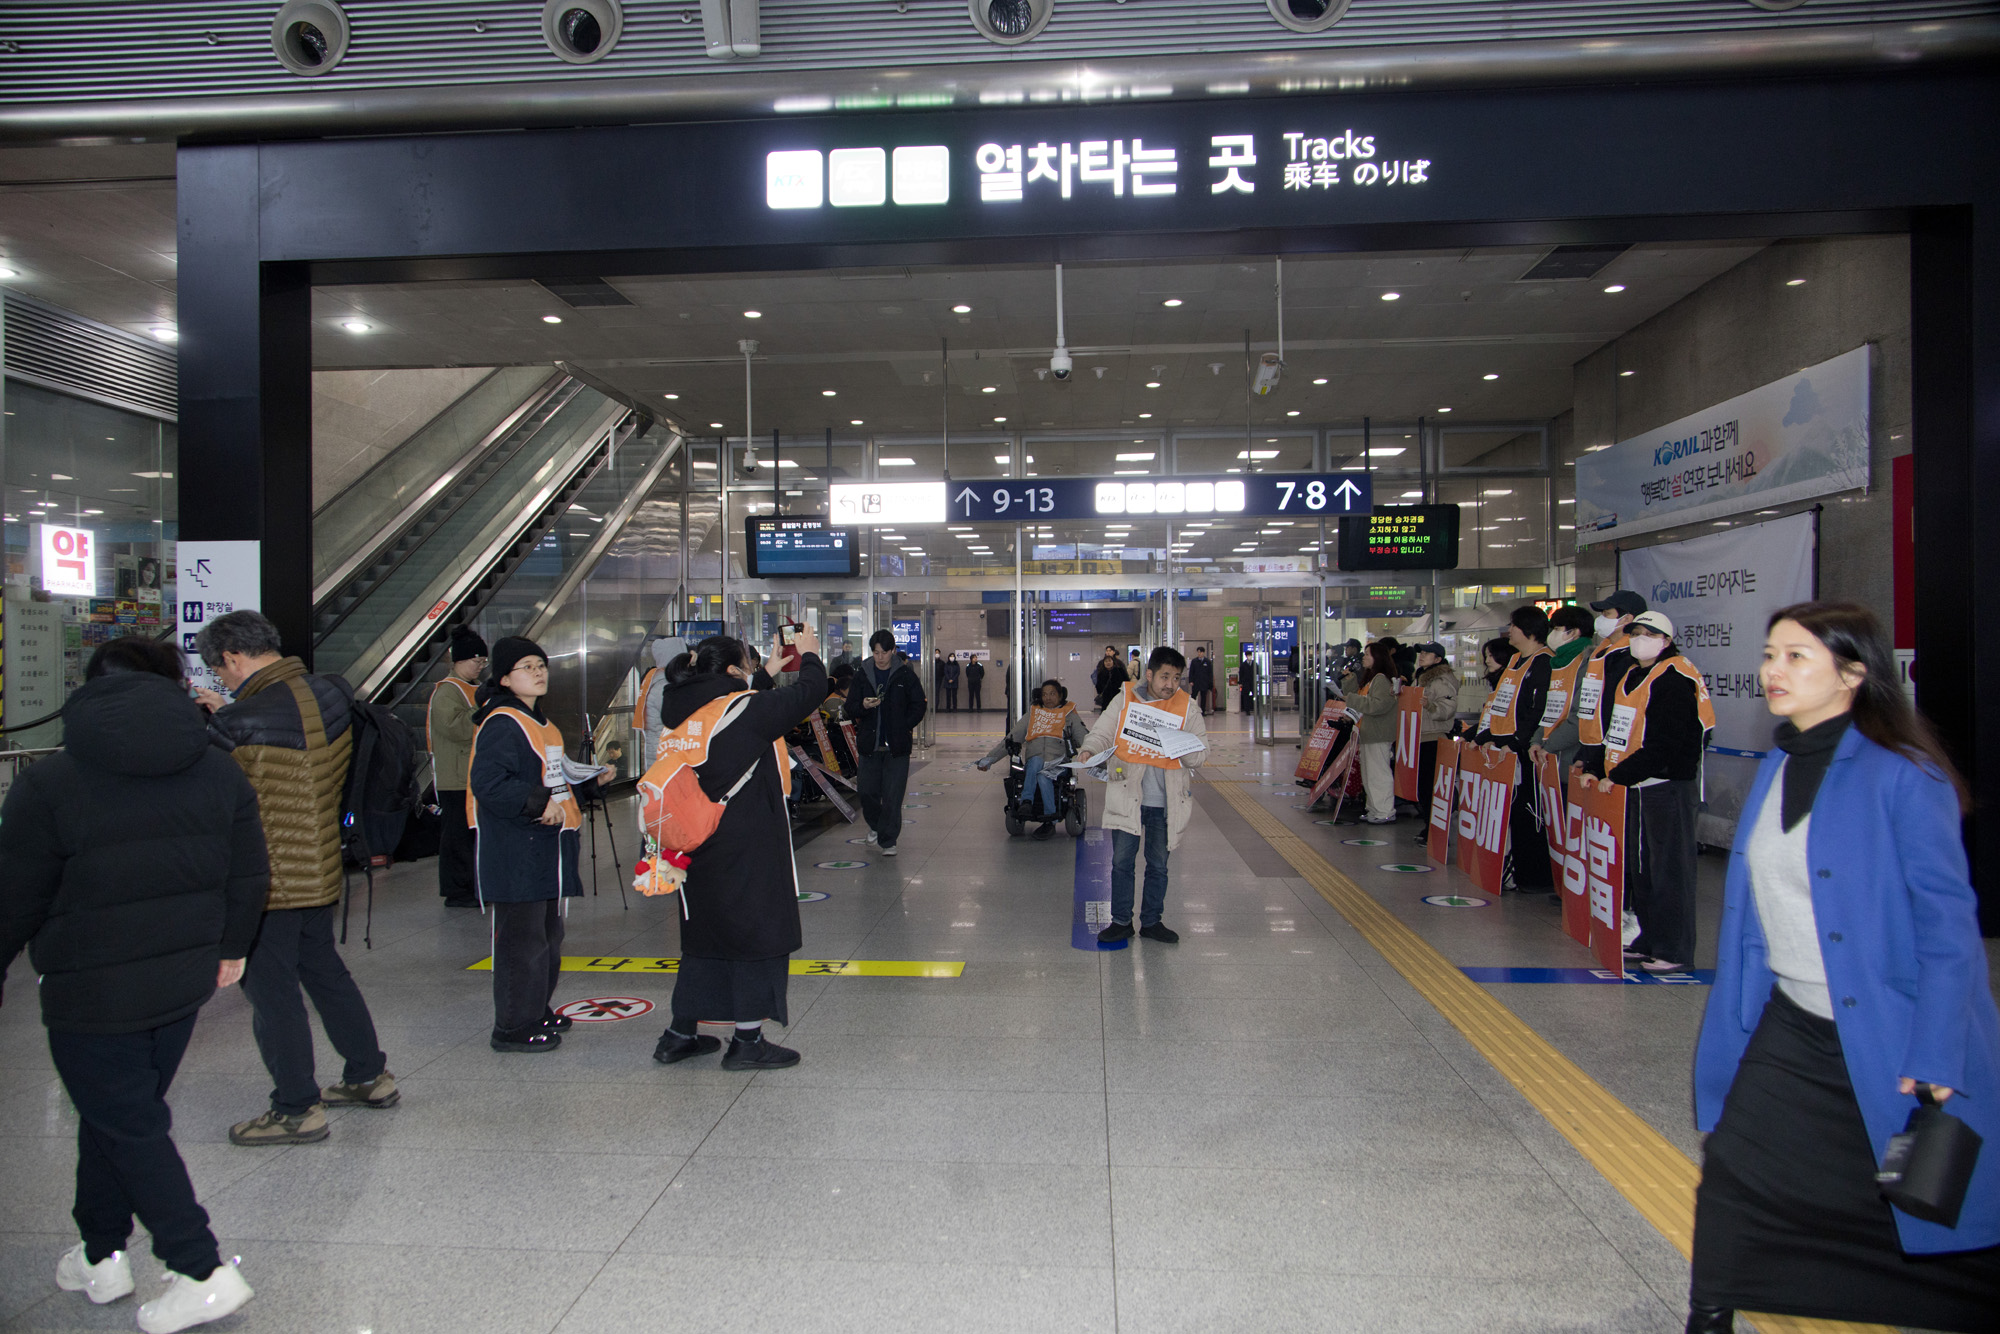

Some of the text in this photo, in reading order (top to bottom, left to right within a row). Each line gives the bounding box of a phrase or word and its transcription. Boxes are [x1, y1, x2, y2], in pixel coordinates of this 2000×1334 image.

[1283, 129, 1376, 161] Tracks
[976, 138, 1178, 204] 열차타는
[1209, 134, 1257, 196] 곳
[1353, 158, 1431, 187] のりば
[1706, 450, 1757, 488] 보내세요
[992, 487, 1055, 514] 9-13
[1369, 525, 1399, 534] 소지하지
[1370, 515, 1425, 524] 정당한 승차권을
[1369, 535, 1430, 545] 열차를 이용하시면
[52, 530, 89, 581] 약
[206, 602, 233, 613] 화장실
[1397, 710, 1418, 769] 시
[1430, 763, 1453, 832] 설
[1458, 769, 1508, 855] 장애
[804, 961, 850, 975] 곳
